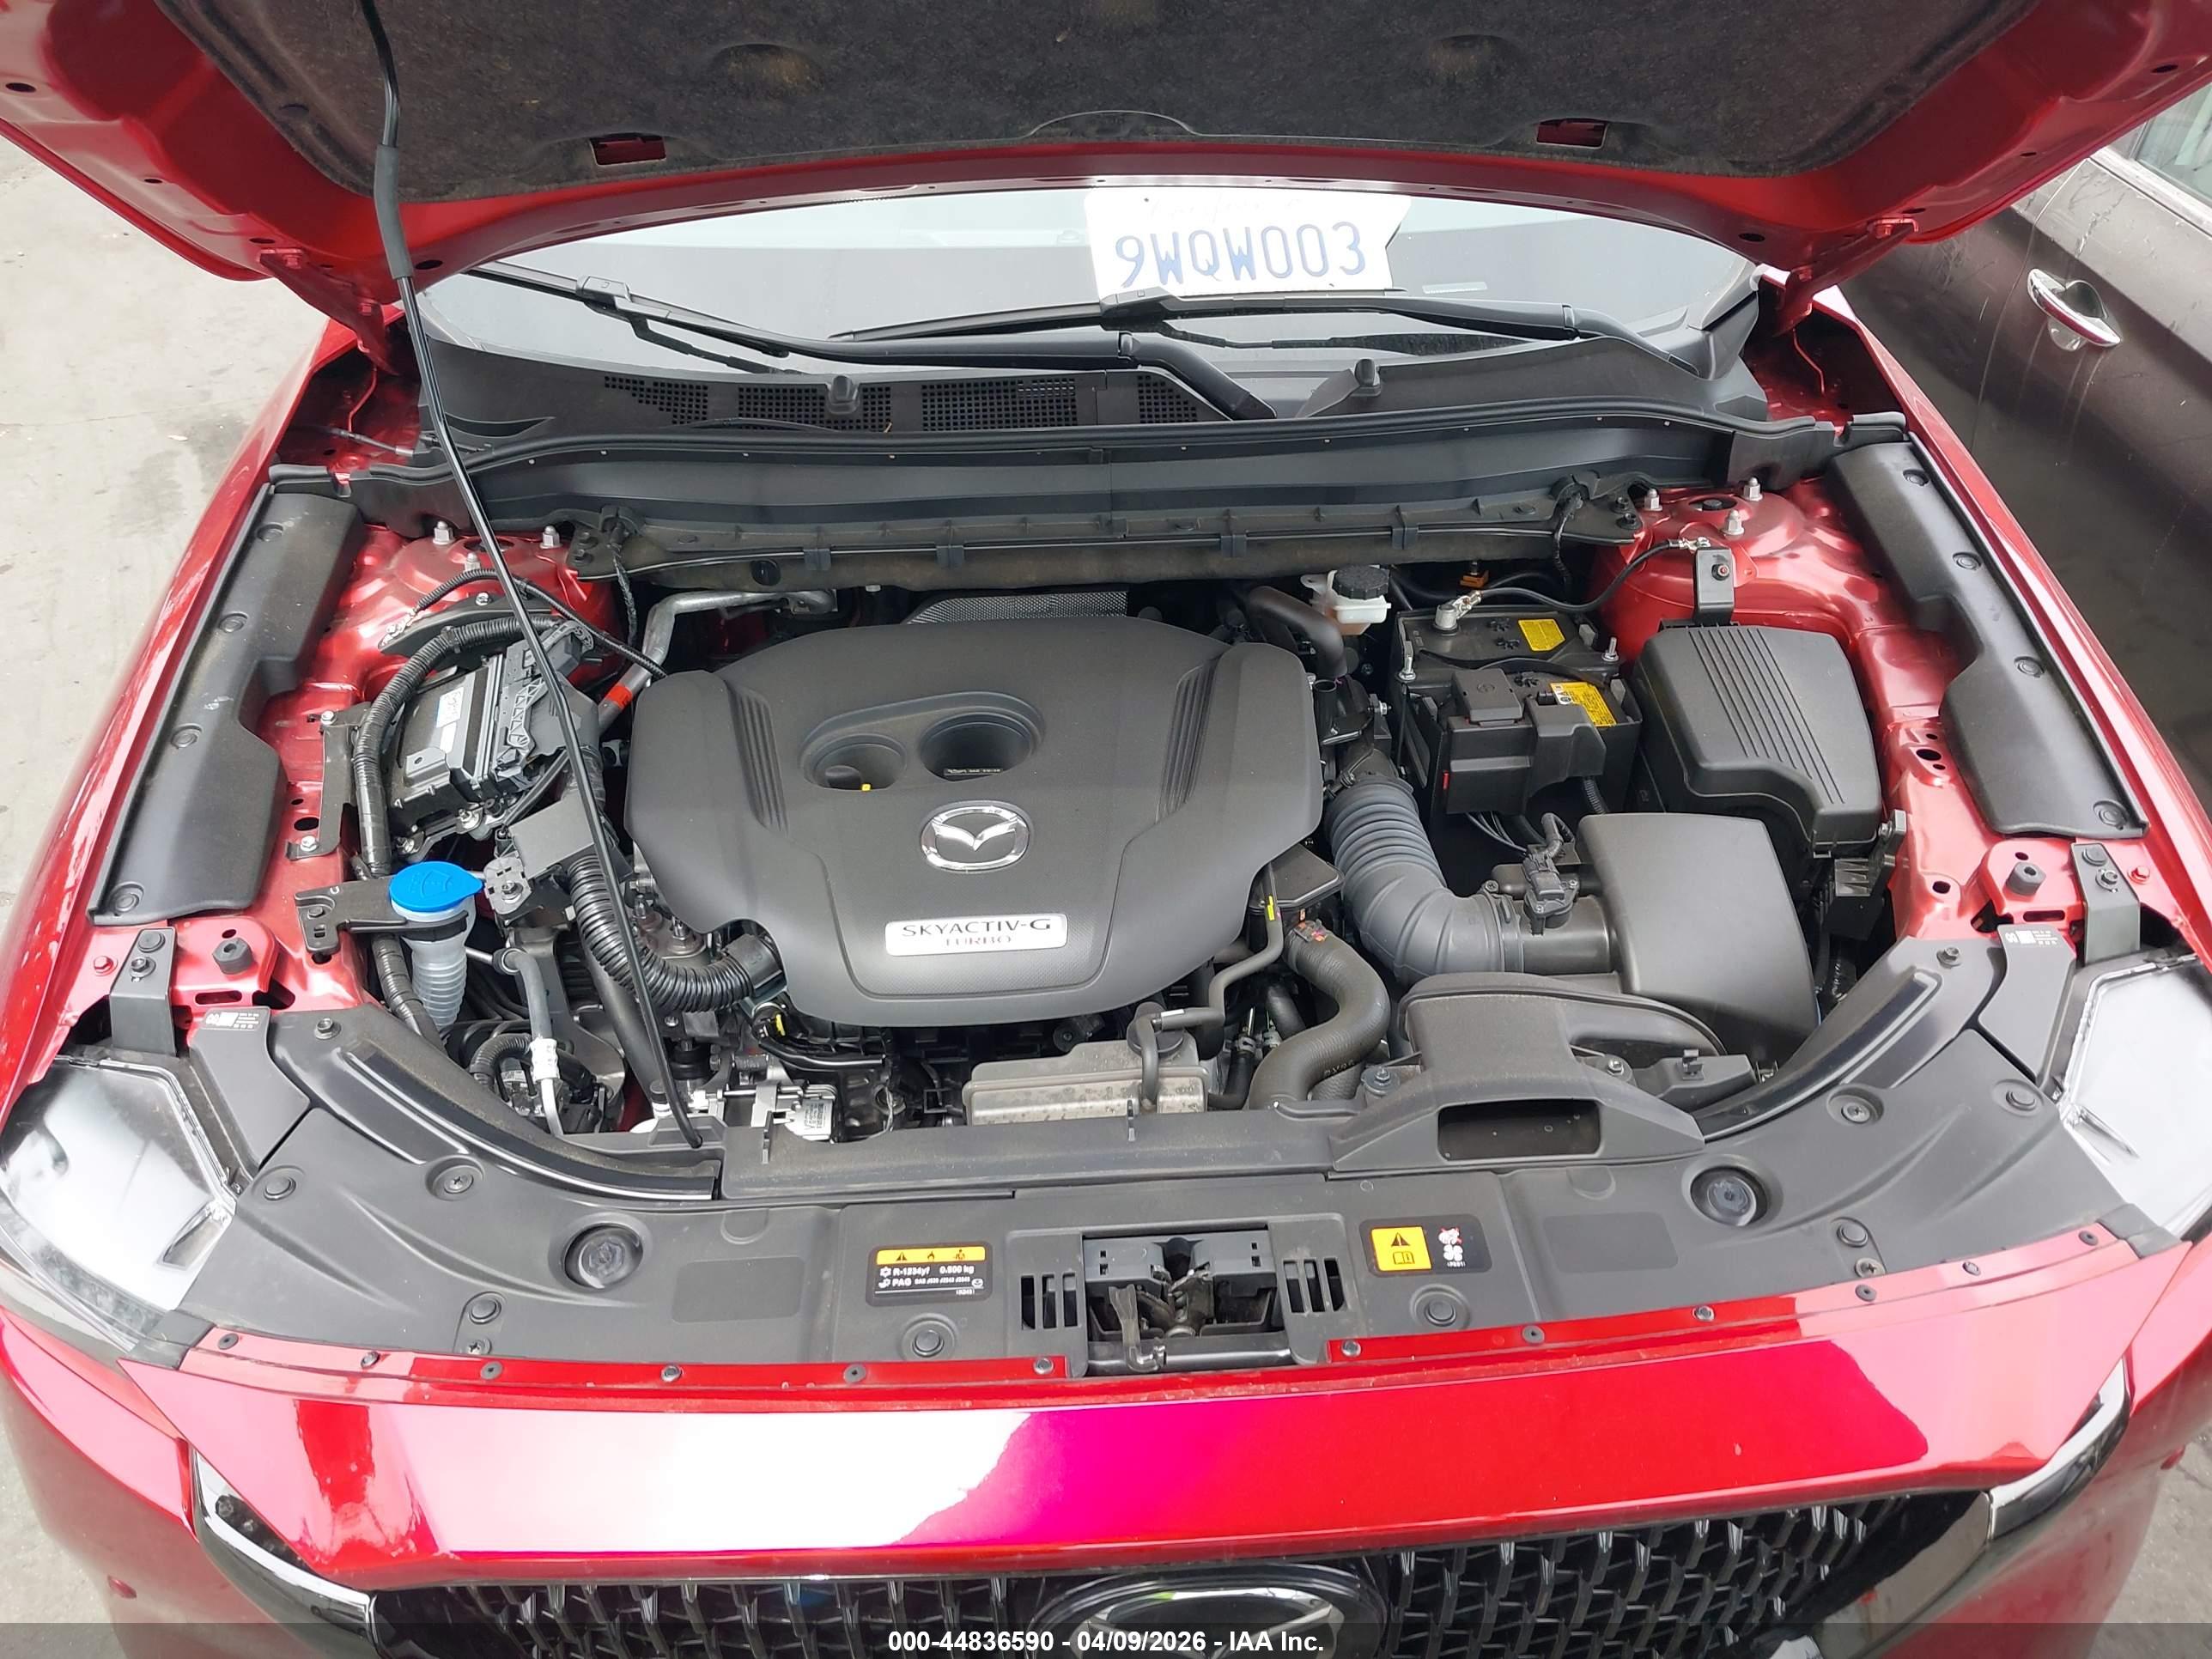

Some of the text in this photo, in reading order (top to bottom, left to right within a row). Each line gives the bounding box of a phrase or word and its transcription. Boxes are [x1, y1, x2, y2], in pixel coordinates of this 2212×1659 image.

[1115, 221, 1366, 289] 9WQW003
[902, 918, 1051, 937] SKYACTIV-G
[944, 935, 1012, 946] TURBO
[963, 1264, 975, 1275] kg
